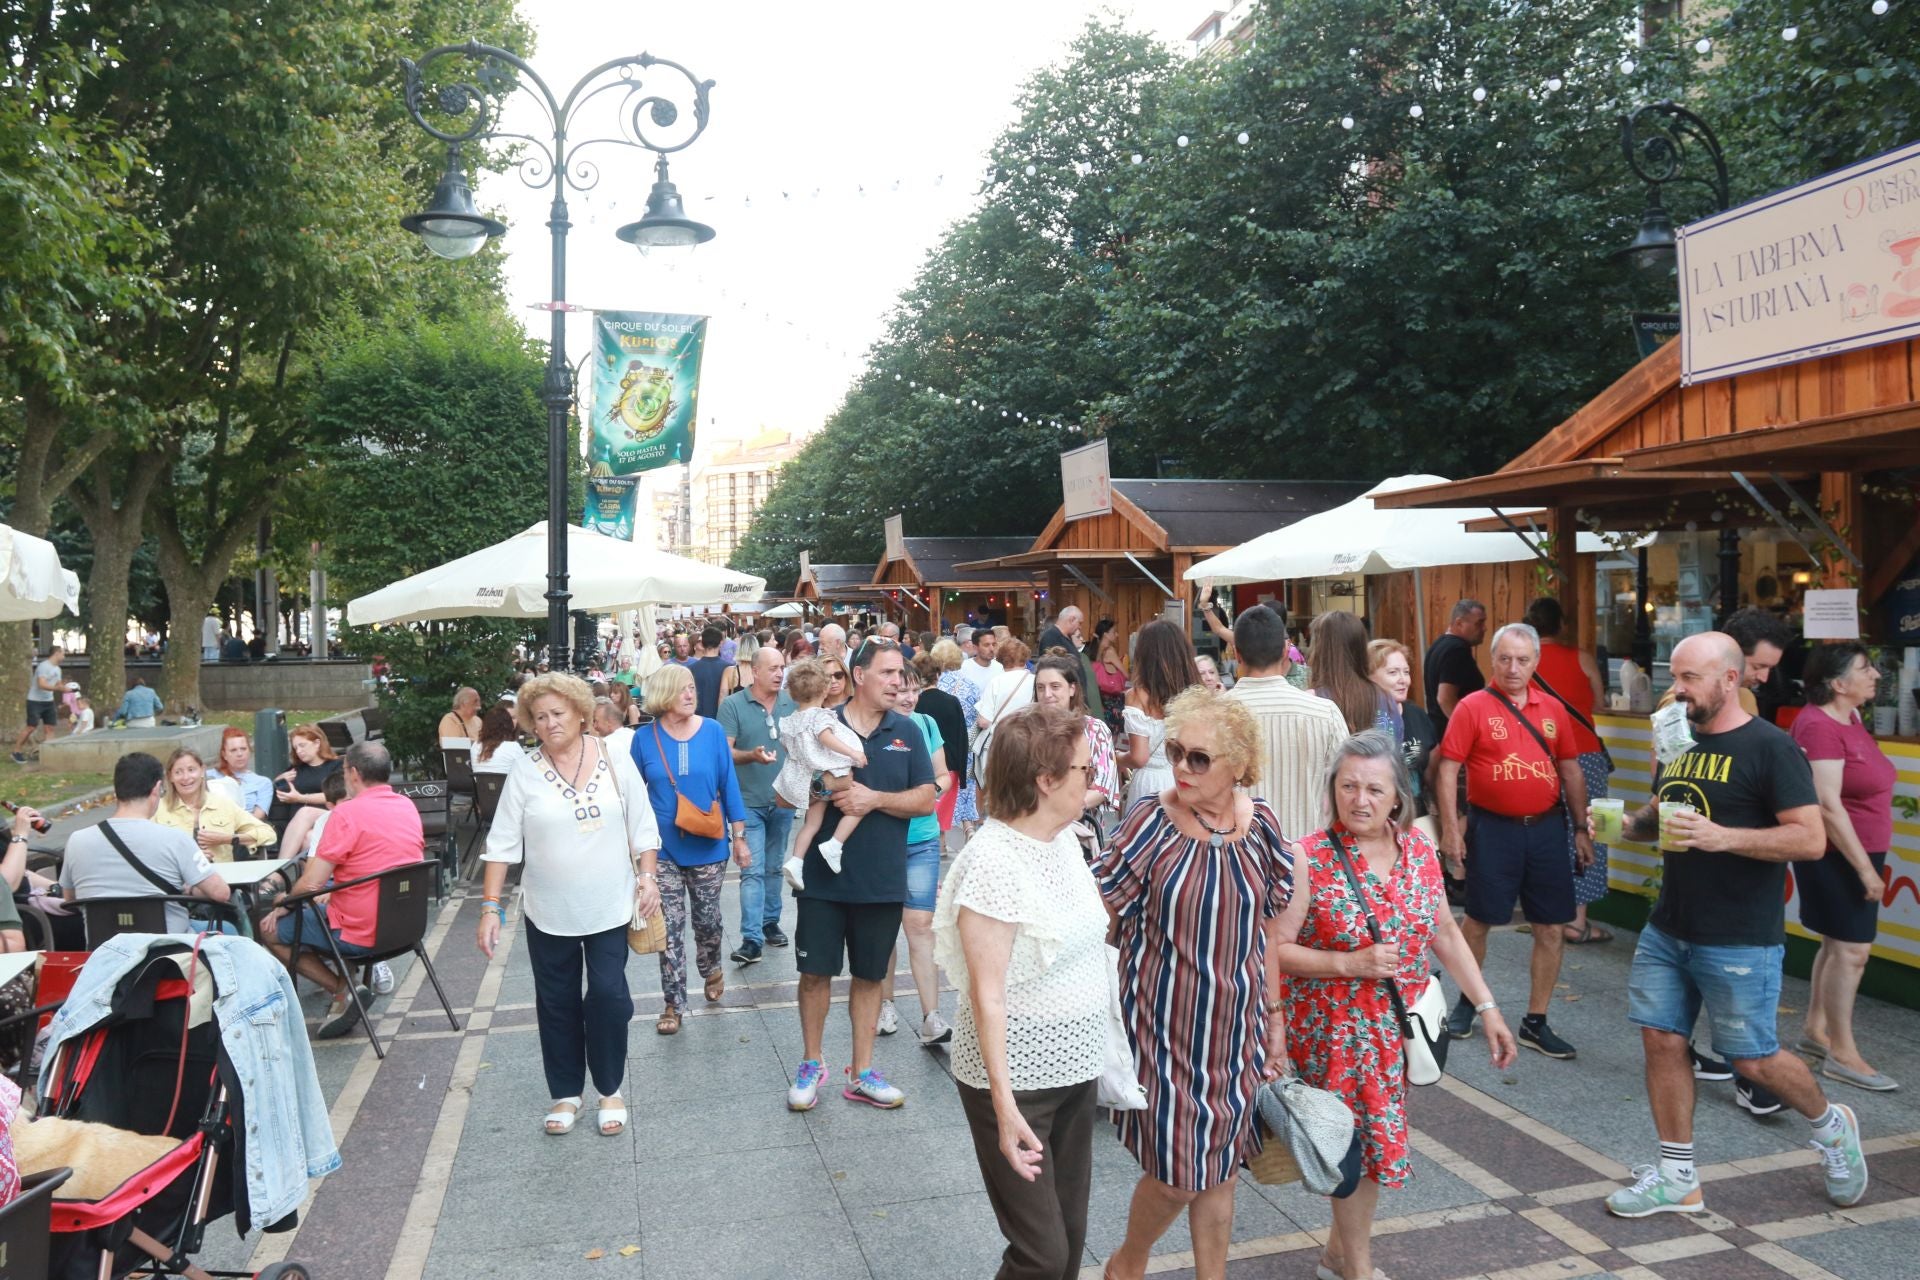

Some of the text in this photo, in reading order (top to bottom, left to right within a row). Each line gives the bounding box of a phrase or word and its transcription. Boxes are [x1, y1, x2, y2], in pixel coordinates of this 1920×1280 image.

[1868, 168, 1918, 198] PASEO
[1843, 186, 1865, 219] 9
[1868, 185, 1920, 213] GASTR
[1694, 223, 1845, 295] LA TABERNA
[1698, 274, 1831, 336] ASTURIANA
[603, 321, 695, 334] CIRQUE DU SOLEIL
[617, 450, 635, 458] SOLO
[637, 445, 658, 455] HASTA
[637, 450, 665, 460] AGOSTO
[1488, 716, 1508, 740] 3
[1492, 764, 1528, 781] PRL
